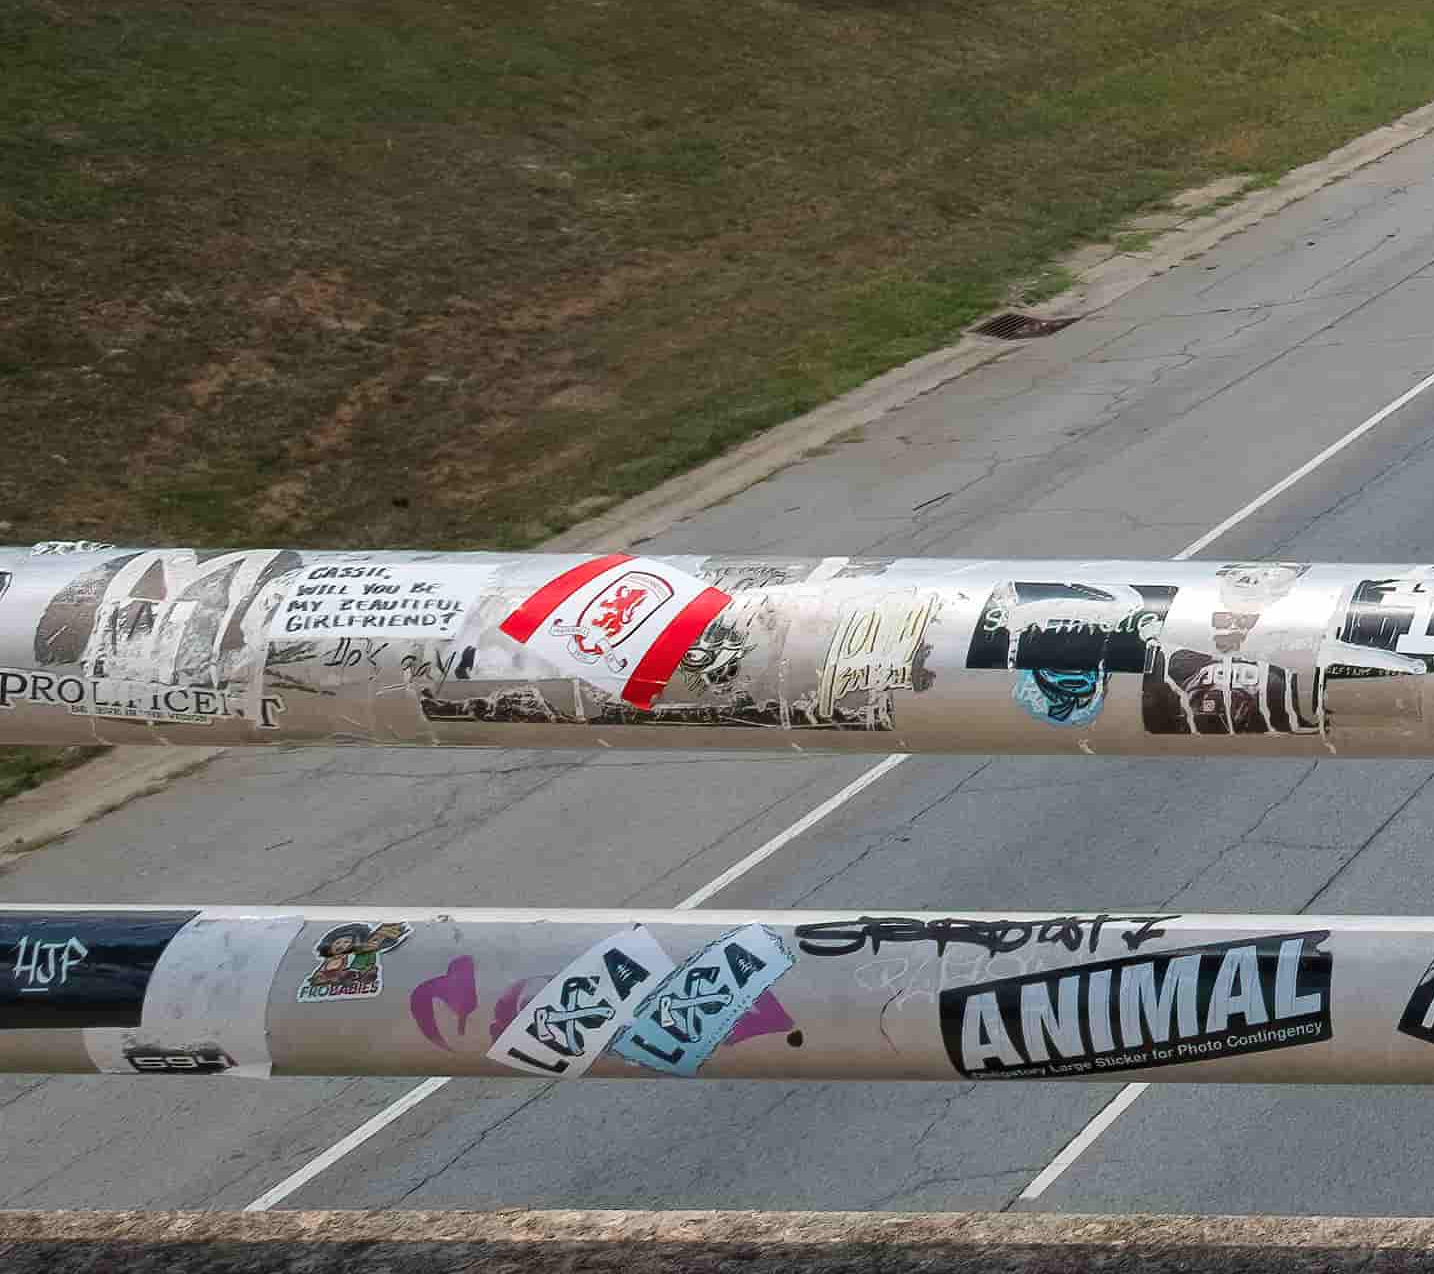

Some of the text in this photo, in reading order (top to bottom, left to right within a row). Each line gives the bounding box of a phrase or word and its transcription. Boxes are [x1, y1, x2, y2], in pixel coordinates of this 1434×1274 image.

[296, 582, 442, 597] WILL YOU BE
[286, 598, 464, 613] MY BEAUTIFUL
[284, 612, 457, 633] GIRLFRIEND?
[299, 979, 380, 998] FROBABIES
[959, 937, 1323, 1072] ANIMAL
[1094, 1051, 1148, 1069] Sticker
[1151, 1047, 1174, 1060] for
[1177, 1040, 1223, 1057] Photo
[1226, 1019, 1324, 1049] Contingency
